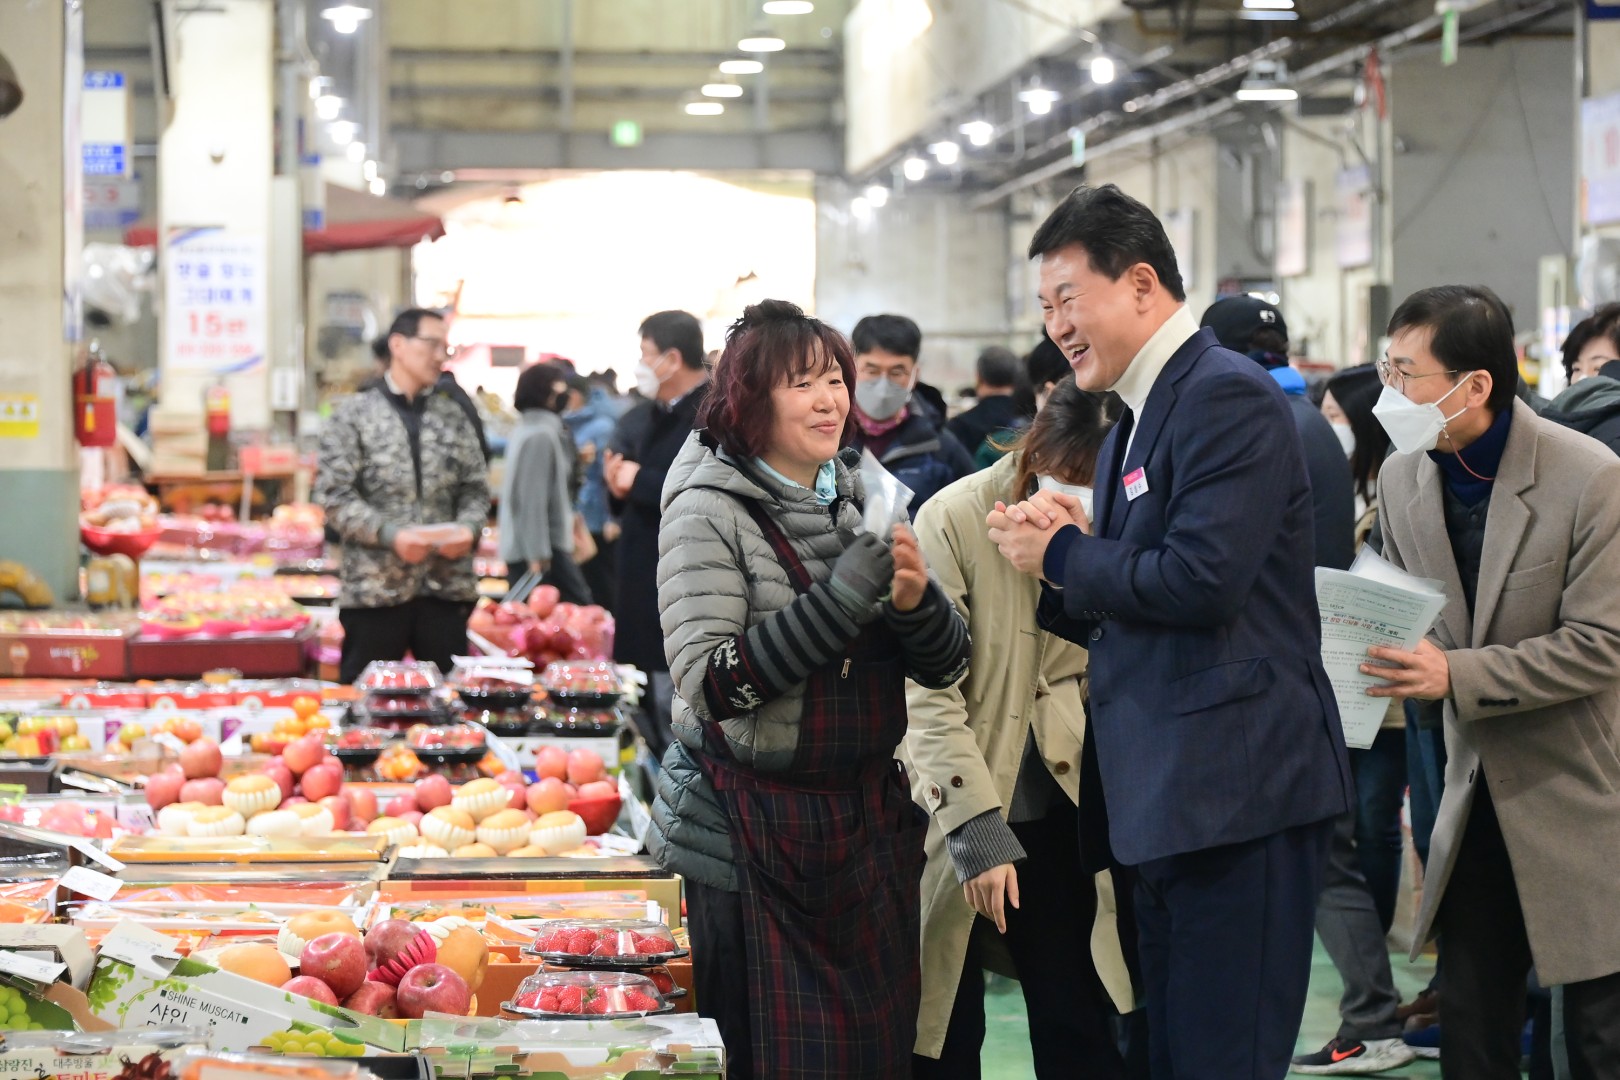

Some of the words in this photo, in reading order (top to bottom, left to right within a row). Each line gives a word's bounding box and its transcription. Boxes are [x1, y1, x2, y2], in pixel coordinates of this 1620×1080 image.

[167, 990, 198, 1009] SHINE
[199, 1001, 242, 1022] MUSCAT
[53, 1057, 94, 1070] 대추방울
